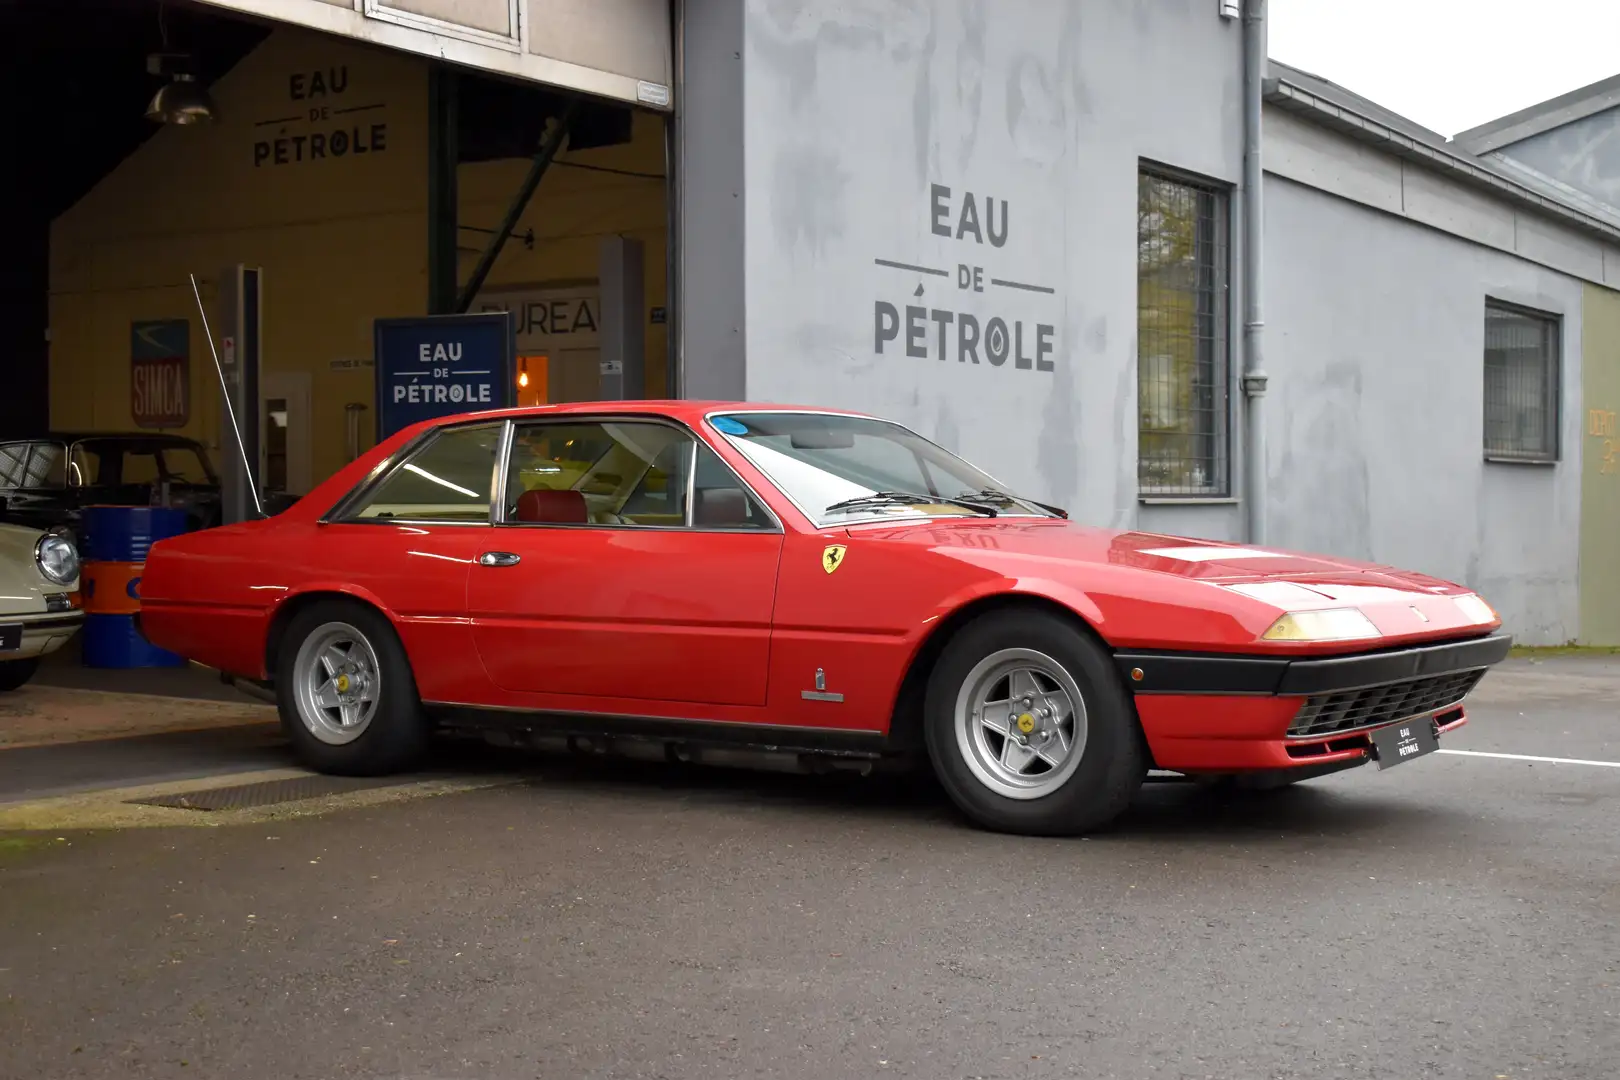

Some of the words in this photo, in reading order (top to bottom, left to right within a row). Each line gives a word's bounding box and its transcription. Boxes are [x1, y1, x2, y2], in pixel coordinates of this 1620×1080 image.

[290, 66, 348, 101] EAU
[309, 107, 329, 122] DE
[254, 124, 387, 168] PÉTROLE
[930, 183, 1008, 248] EAU
[957, 263, 984, 293] DE
[482, 300, 601, 336] UREA
[874, 283, 1055, 373] PÉTROLE
[419, 342, 463, 362] EAU
[434, 367, 449, 378] DE
[133, 363, 184, 416] SIMCA
[393, 376, 492, 404] PÉTROLE
[1400, 728, 1410, 738] EAU
